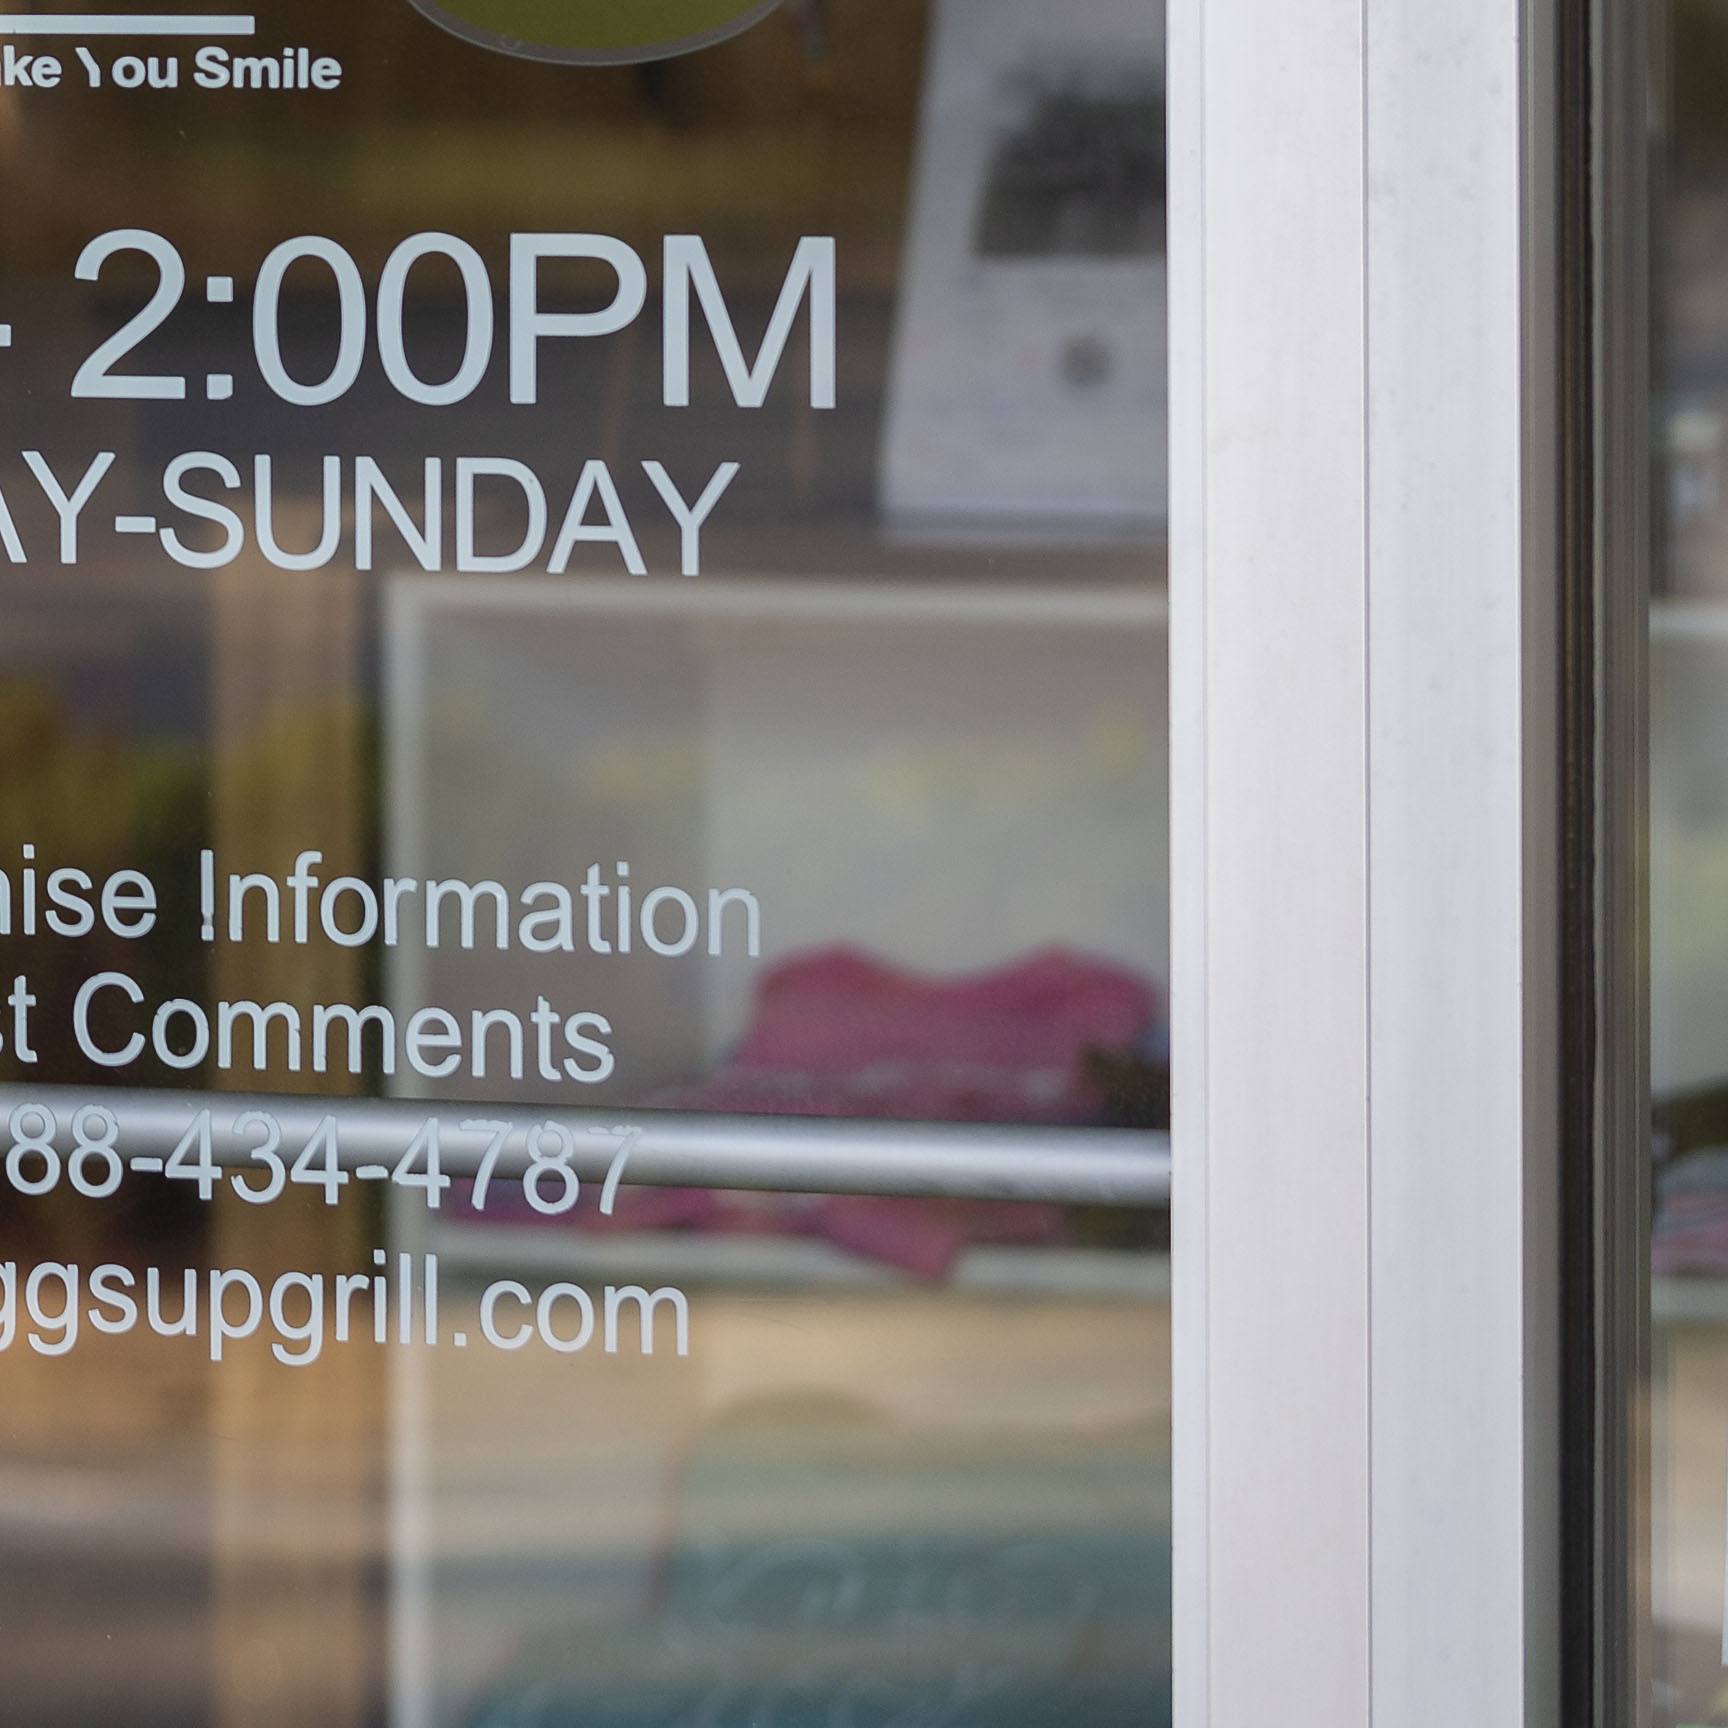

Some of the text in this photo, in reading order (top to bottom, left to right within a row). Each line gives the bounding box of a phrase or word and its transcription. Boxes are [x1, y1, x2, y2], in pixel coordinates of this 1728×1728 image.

[194, 47, 341, 89] Smile
[71, 230, 835, 408] 2:00PM
[201, 851, 763, 960] Information
[72, 972, 617, 1084] Comments
